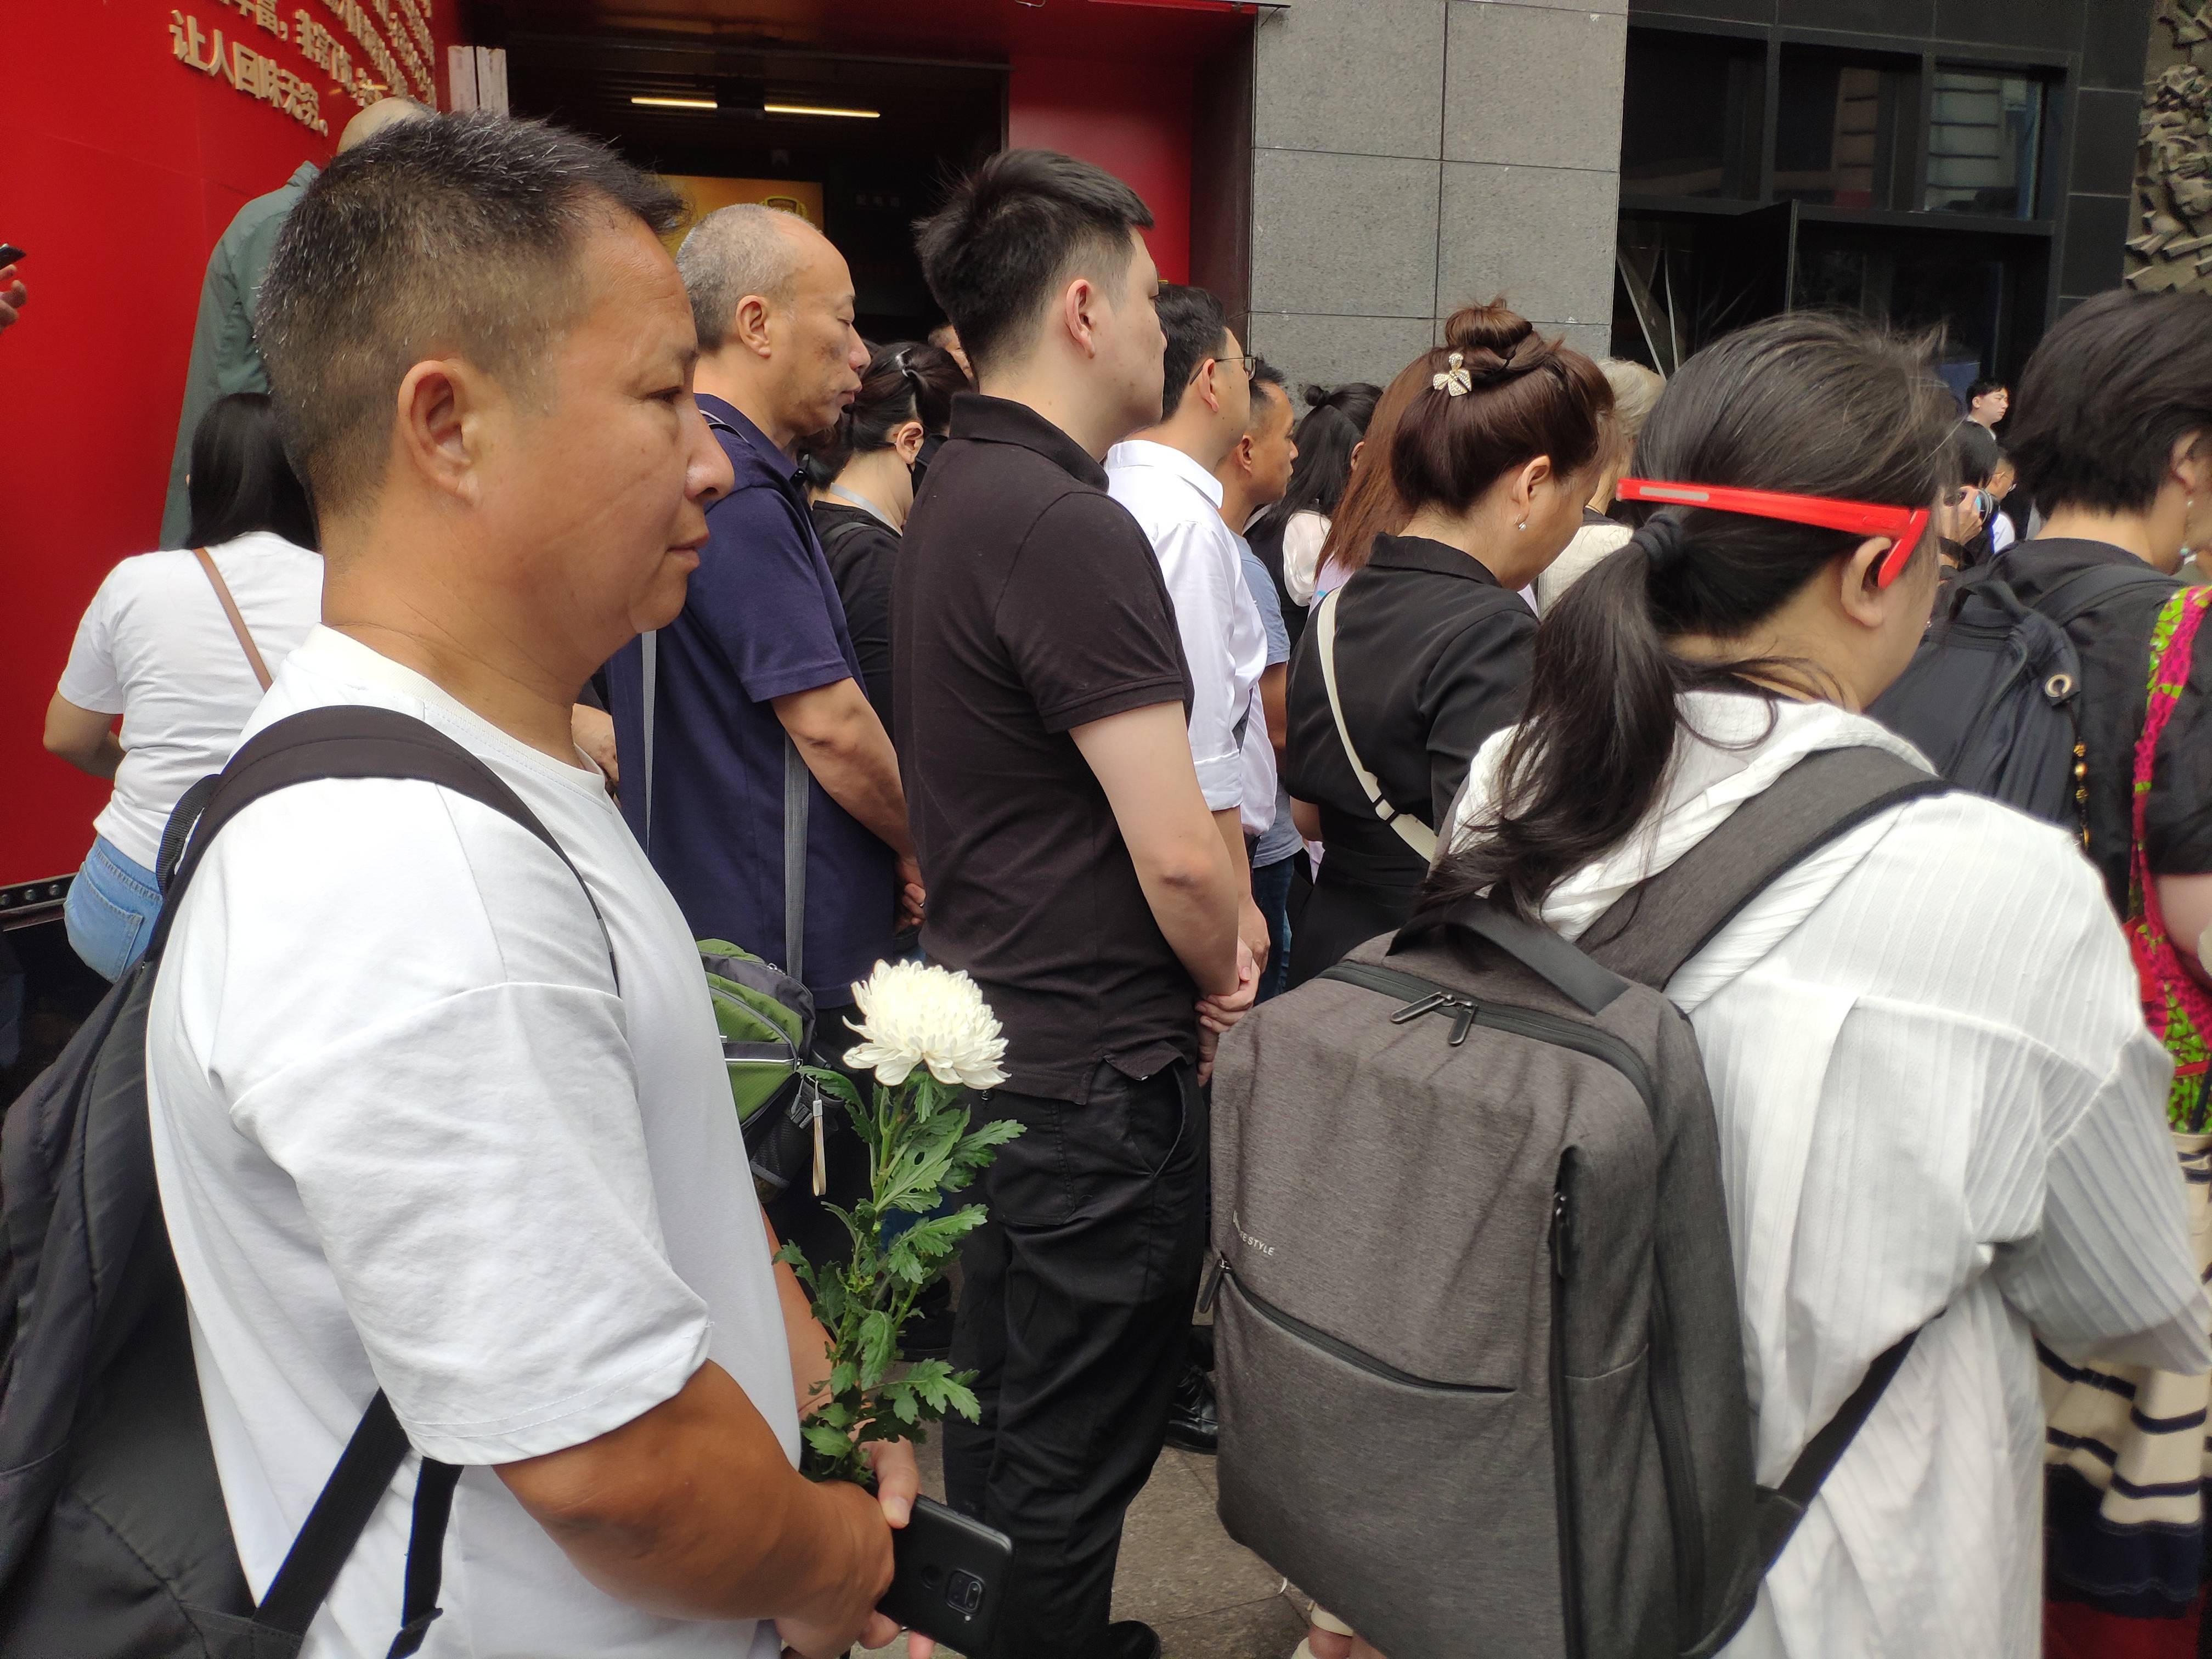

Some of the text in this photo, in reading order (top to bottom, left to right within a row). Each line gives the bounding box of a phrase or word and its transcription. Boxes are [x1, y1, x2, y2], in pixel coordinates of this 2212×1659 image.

[169, 9, 328, 137] 让人回味无穷。
